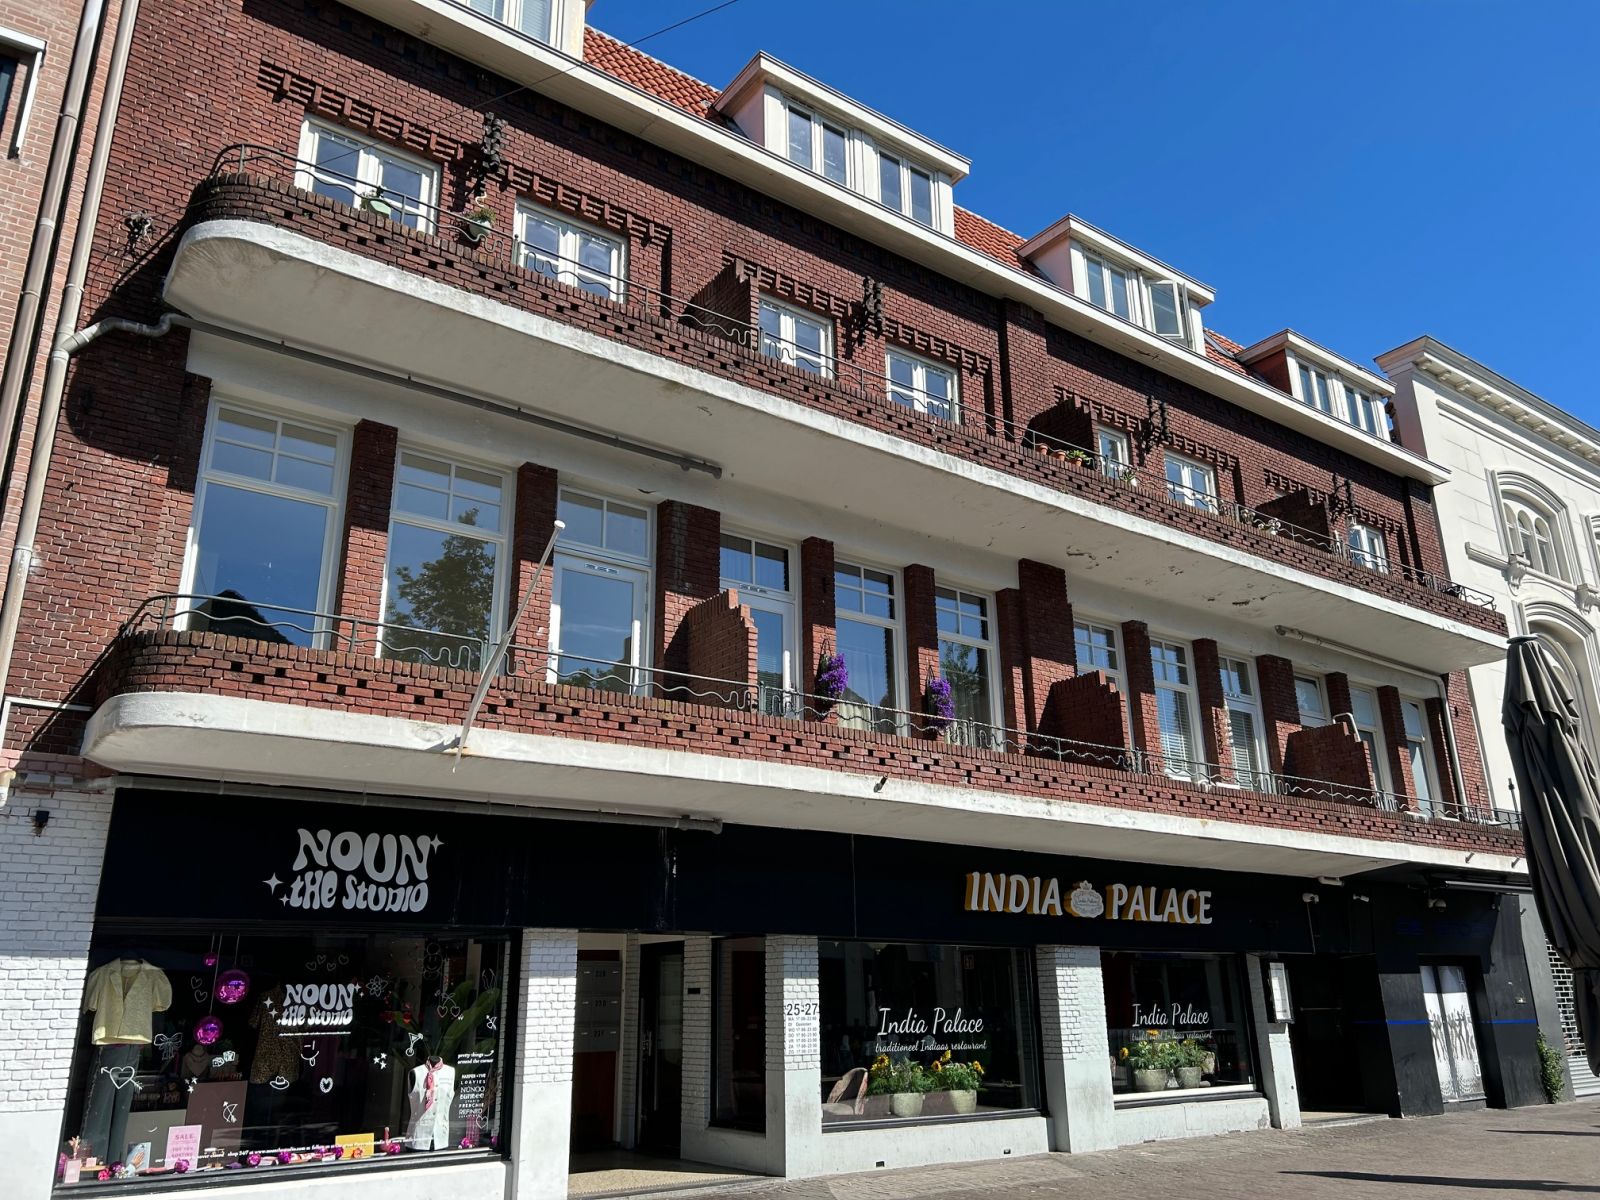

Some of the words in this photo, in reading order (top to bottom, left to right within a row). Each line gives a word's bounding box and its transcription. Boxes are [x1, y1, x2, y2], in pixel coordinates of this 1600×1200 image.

[292, 828, 431, 885] NOUN
[968, 871, 1063, 916] INDIA
[1108, 883, 1213, 925] PALACE
[282, 983, 355, 1011] NOUN
[786, 1003, 818, 1016] 25-27
[877, 1007, 928, 1036] India
[932, 1007, 984, 1035] Palace
[1132, 1003, 1168, 1027] India
[1171, 1002, 1209, 1026] Palace
[875, 1040, 919, 1053] traditioneel
[920, 1039, 949, 1052] Indiaas
[951, 1040, 987, 1050] restaurant
